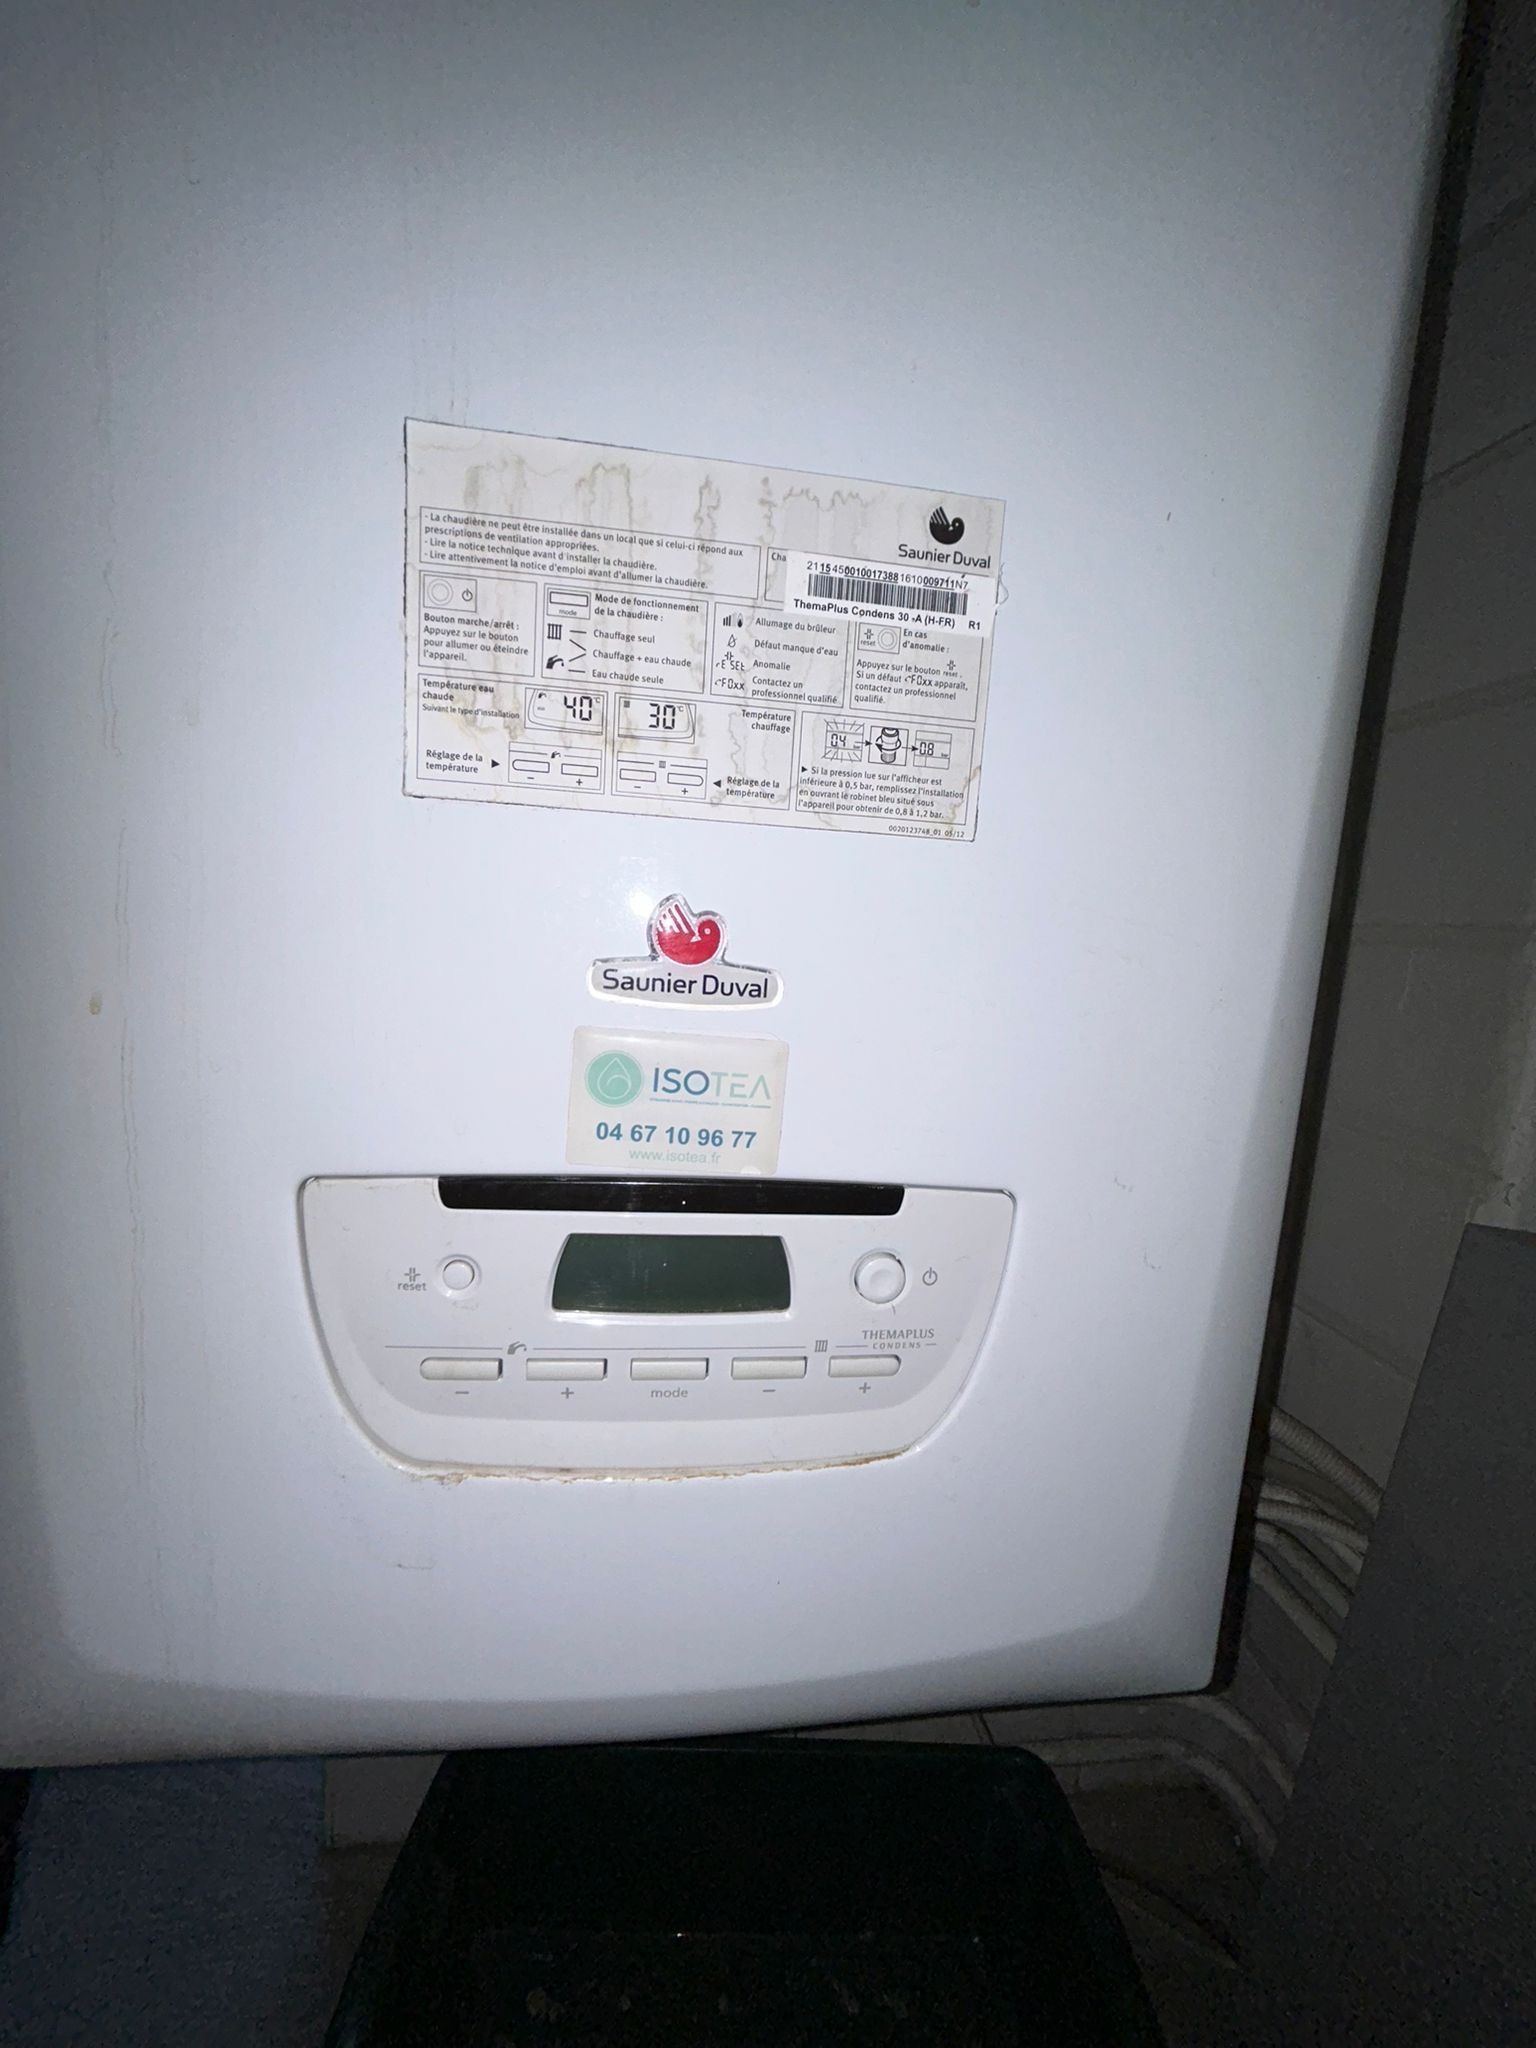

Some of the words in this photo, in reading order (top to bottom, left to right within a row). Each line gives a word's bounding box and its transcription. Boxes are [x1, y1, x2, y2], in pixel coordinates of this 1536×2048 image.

[425, 527, 482, 539] prescriptions
[485, 532, 495, 540] de
[497, 534, 543, 545] ventilation
[545, 540, 600, 552] appropriées.
[443, 514, 486, 527] chaudière
[501, 522, 520, 531] peut
[523, 524, 540, 533] être
[542, 527, 578, 537] installée
[580, 530, 600, 540] dans
[617, 534, 636, 544] local
[665, 541, 695, 551] celui-ci
[697, 544, 726, 554] répond
[430, 538, 446, 547] Lire
[449, 540, 456, 548] la
[459, 542, 484, 551] notice
[487, 545, 530, 557] technique
[533, 551, 556, 559] avant
[604, 556, 611, 565] la
[613, 559, 657, 570] chaudière.
[898, 544, 950, 563] Saunier
[953, 551, 991, 569] Duval
[430, 551, 446, 560] Lire
[448, 553, 508, 567] attentivement
[511, 559, 518, 567] la
[520, 562, 546, 570] notice
[549, 563, 586, 575] d'emploi
[588, 570, 611, 578] avant
[614, 570, 652, 583] d'allumer
[655, 575, 662, 583] la
[665, 577, 708, 589] chaudière.
[595, 594, 618, 603] Mode
[621, 596, 631, 605] de
[633, 598, 699, 612] fonctionnement
[424, 613, 455, 623] Bouton
[595, 607, 605, 615] de
[607, 608, 615, 616] la
[617, 610, 658, 621] chaudière
[794, 599, 848, 615] ThemaPlus
[851, 606, 895, 620] Condens
[898, 612, 909, 622] 30
[924, 614, 955, 629] (H-FR)
[969, 620, 980, 630] R1
[755, 618, 792, 629] Allumage
[795, 623, 806, 631] du
[424, 626, 461, 636] Appuyez
[463, 630, 476, 638] sur
[479, 630, 486, 639] le
[489, 632, 518, 641] bouton
[594, 629, 635, 642] Chauffage
[638, 635, 655, 643] seul
[903, 629, 913, 637] En
[424, 639, 443, 647] pour
[446, 640, 478, 650] allumer
[493, 644, 528, 655] éteindre
[754, 640, 781, 650] Défaut
[783, 644, 814, 655] manque
[593, 649, 634, 662] Chauffage
[661, 656, 691, 667] chaude
[753, 660, 791, 671] Anomalie
[857, 659, 889, 671] Appuyez
[891, 663, 903, 671] sur
[905, 664, 912, 672] le
[914, 665, 940, 675] bouton
[592, 670, 607, 678] Eau
[609, 672, 639, 682] chaude
[642, 675, 663, 684] seule
[752, 676, 791, 688] Contactez
[878, 673, 901, 683] défaut
[422, 679, 477, 692] Température
[479, 684, 494, 693] eau
[855, 682, 891, 693] contactez
[905, 688, 956, 699] professionnel
[422, 692, 454, 701] chaude
[752, 689, 806, 700] professionnel
[564, 695, 592, 721] 40
[649, 703, 676, 729] 30
[742, 709, 792, 722] Température
[752, 722, 791, 733] chauffage
[426, 750, 461, 761] Réglage
[426, 762, 478, 773] température
[811, 766, 819, 774] Si
[821, 767, 828, 775] la
[830, 769, 862, 779] pression
[865, 772, 875, 780] lue
[727, 776, 759, 787] Réglage
[761, 779, 771, 787] de
[773, 779, 780, 788] la
[800, 778, 837, 787] inférieure
[876, 785, 916, 795] remplissez
[726, 789, 775, 799] température
[810, 790, 839, 798] ouvrant
[850, 793, 877, 801] robinet
[879, 796, 895, 804] bleu
[897, 797, 914, 805] situé
[836, 804, 854, 812] pour
[856, 805, 882, 813] obtenir
[885, 806, 893, 814] de
[603, 968, 697, 994] Saunier
[702, 974, 768, 998] Duval
[653, 1067, 771, 1100] ISOTEA
[596, 1122, 623, 1141] 04
[630, 1125, 657, 1143] 67
[665, 1127, 690, 1144] 10
[697, 1128, 723, 1147] 96
[731, 1130, 757, 1149] 77
[629, 1149, 721, 1164] www.isotea.fr
[398, 1282, 426, 1291] reset
[862, 1329, 934, 1339] THEMAPLUS
[650, 1387, 688, 1398] mode
